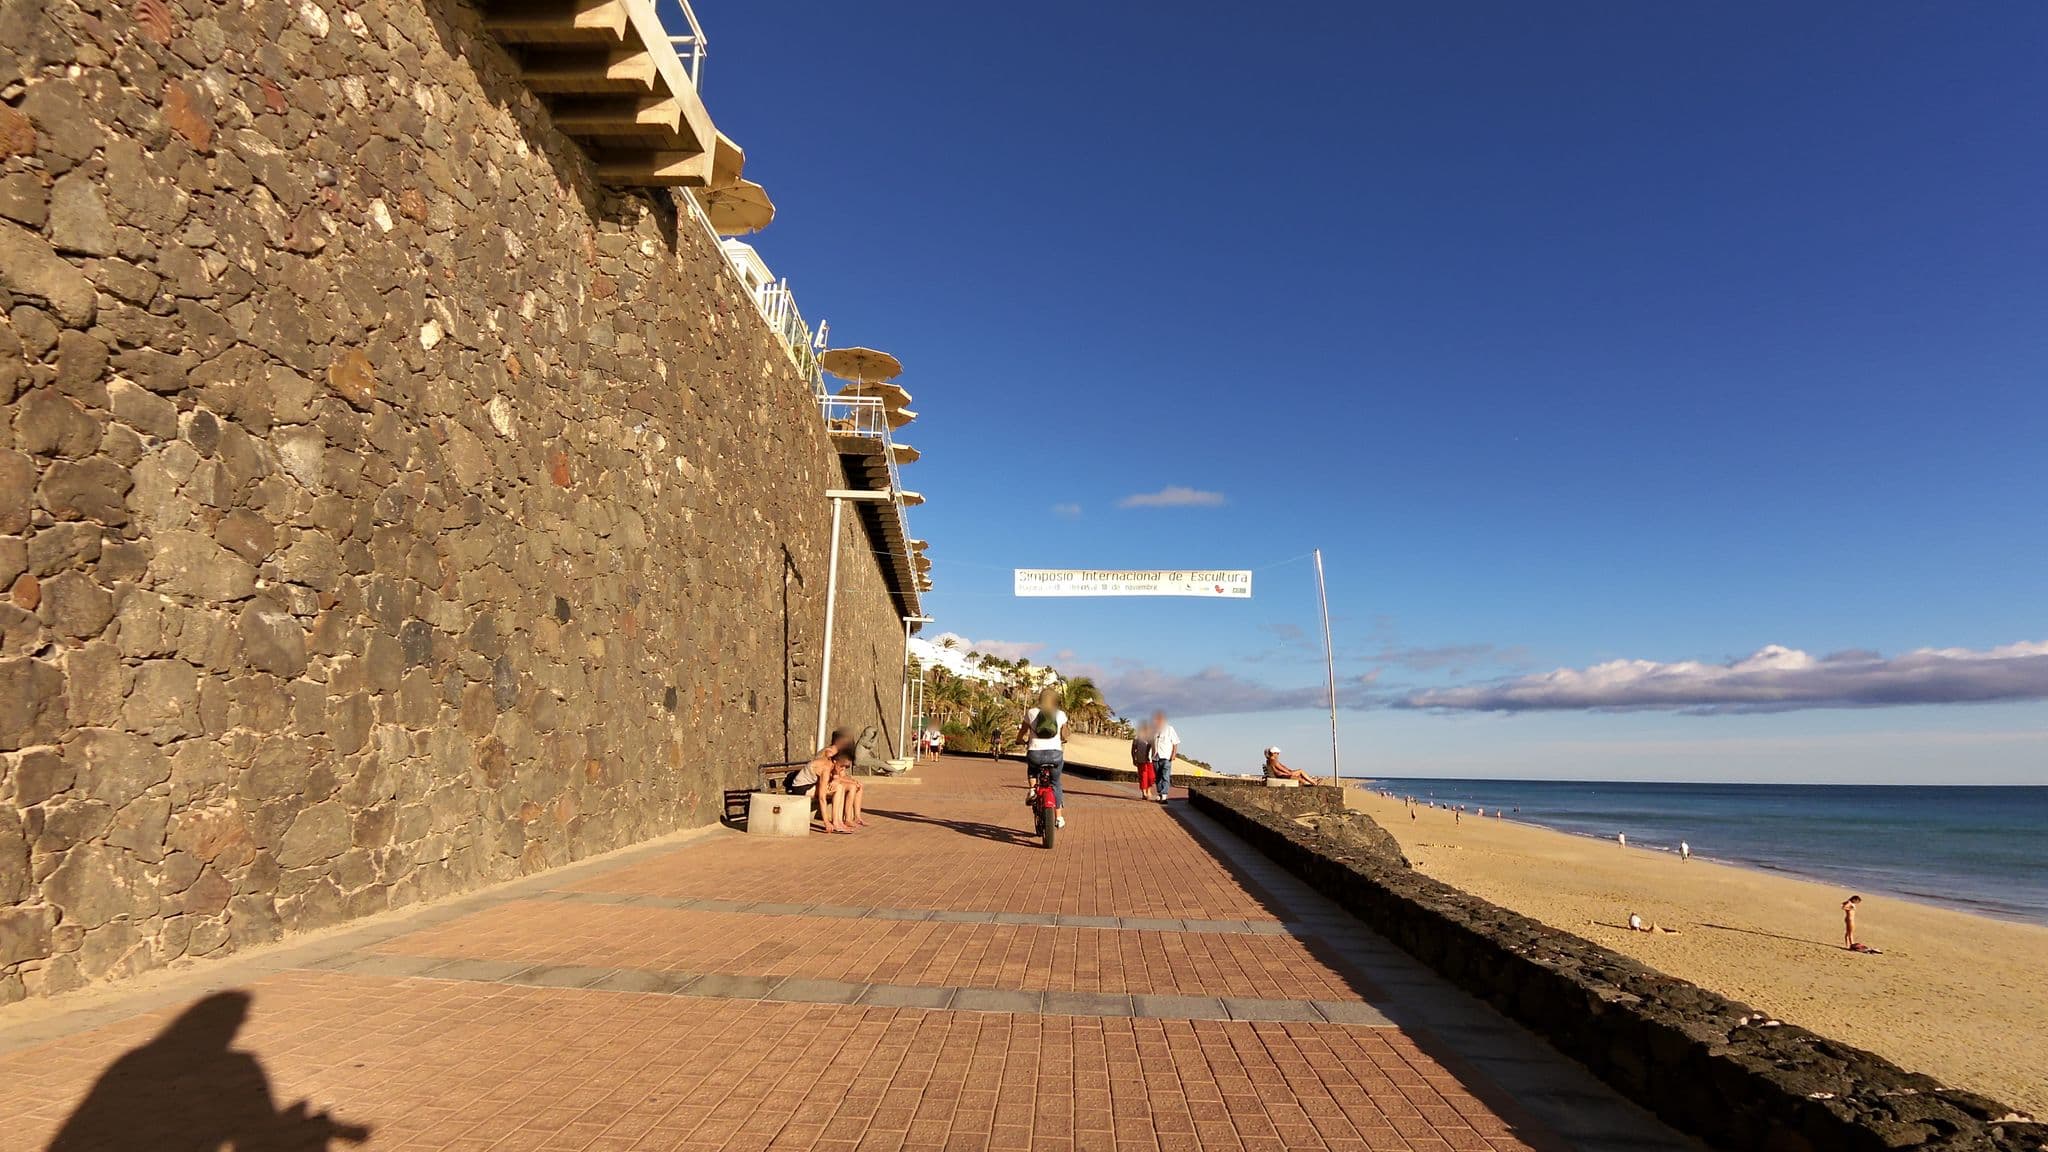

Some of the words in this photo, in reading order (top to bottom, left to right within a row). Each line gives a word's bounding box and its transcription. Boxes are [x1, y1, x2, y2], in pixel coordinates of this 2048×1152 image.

[1019, 571, 1073, 583] Simposio
[1082, 571, 1161, 581] Internacional
[1168, 571, 1183, 581] de
[1190, 571, 1248, 583] Escultura
